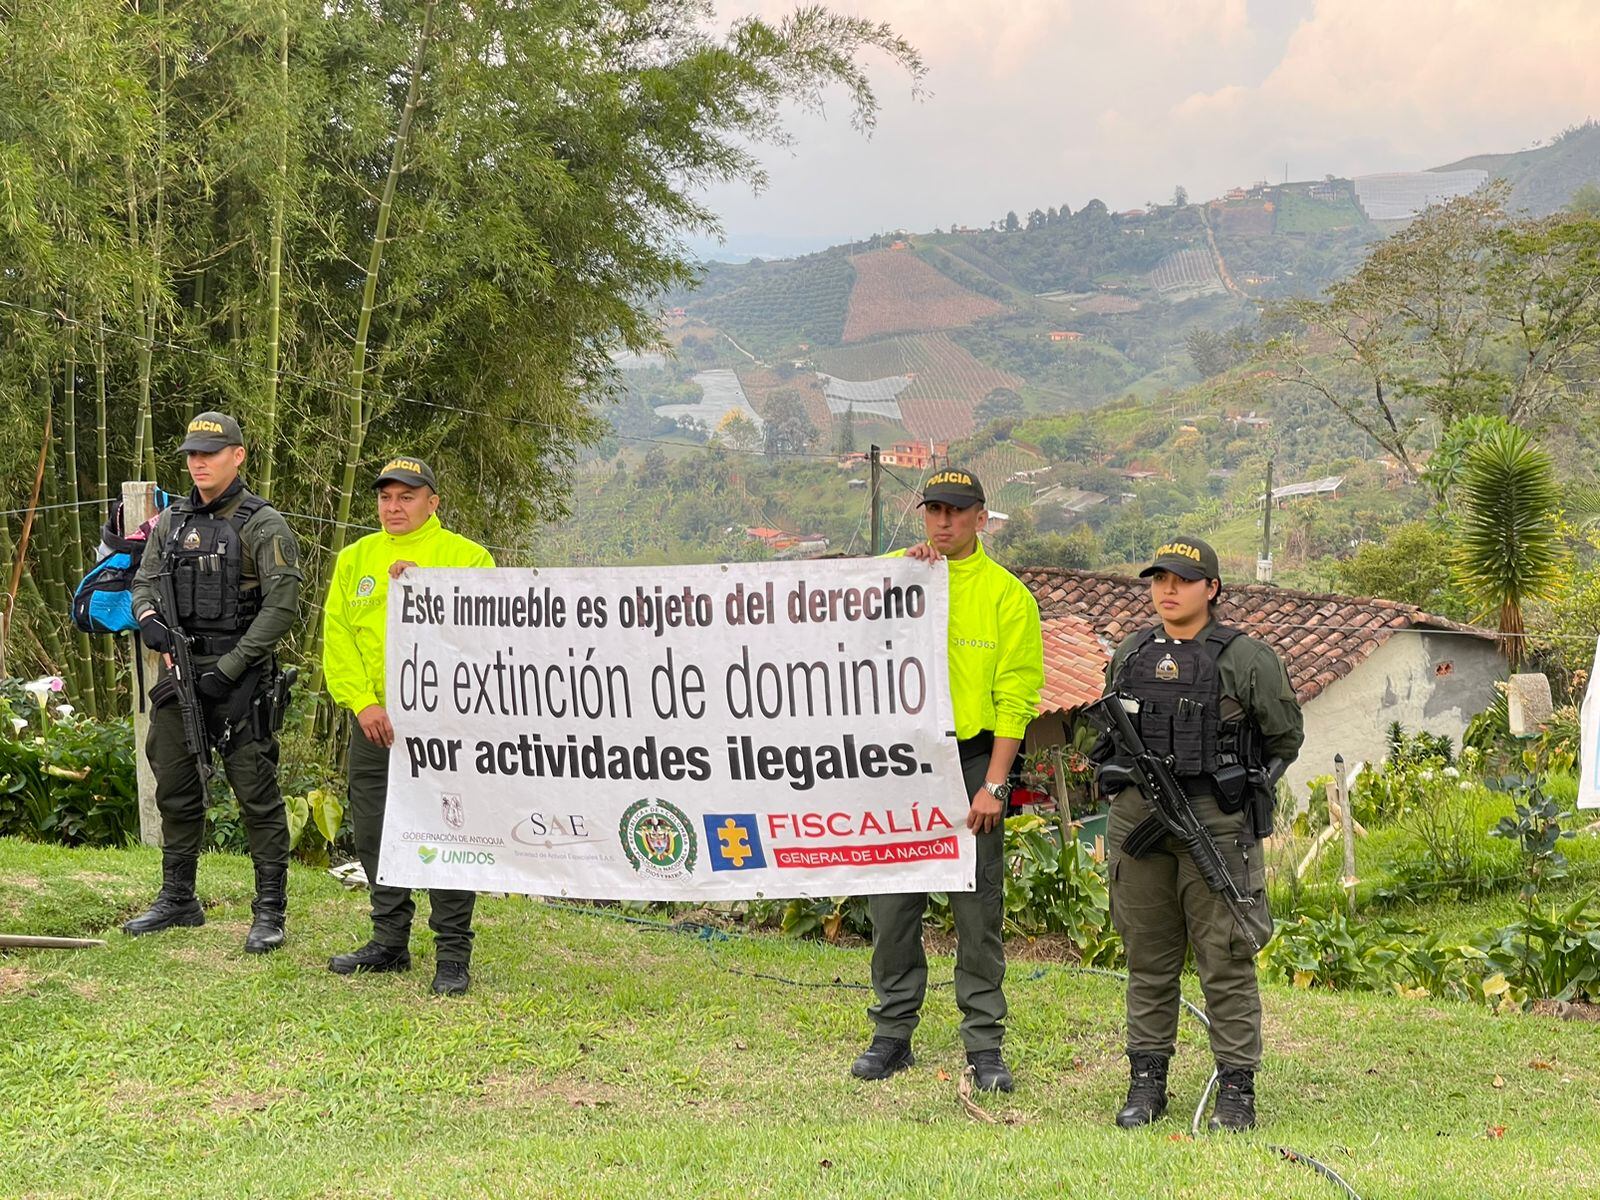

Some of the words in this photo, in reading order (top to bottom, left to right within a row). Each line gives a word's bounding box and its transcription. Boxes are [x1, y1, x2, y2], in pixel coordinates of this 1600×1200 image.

[926, 472, 972, 488] POLICIA
[402, 585, 445, 625] Este
[453, 586, 566, 628] inmueble
[576, 595, 608, 629] es
[619, 585, 713, 637] objeto
[725, 581, 775, 626] del
[787, 577, 925, 624] derecho
[400, 642, 439, 713] de
[453, 646, 632, 720] extinción
[651, 646, 706, 719] de
[725, 639, 926, 719] dominio
[405, 736, 463, 778] por
[474, 733, 712, 782] actividades
[726, 733, 933, 791] ilegales.
[530, 812, 589, 837] SAE
[767, 801, 955, 839] FISCALÍA
[402, 831, 458, 842] GOBERNACIÓN
[459, 834, 468, 844] DE
[441, 850, 496, 865] UNIDOS
[779, 850, 849, 865] GENERAL
[851, 849, 872, 863] DE
[875, 847, 895, 861] LA
[896, 840, 955, 860] NACIÓN
